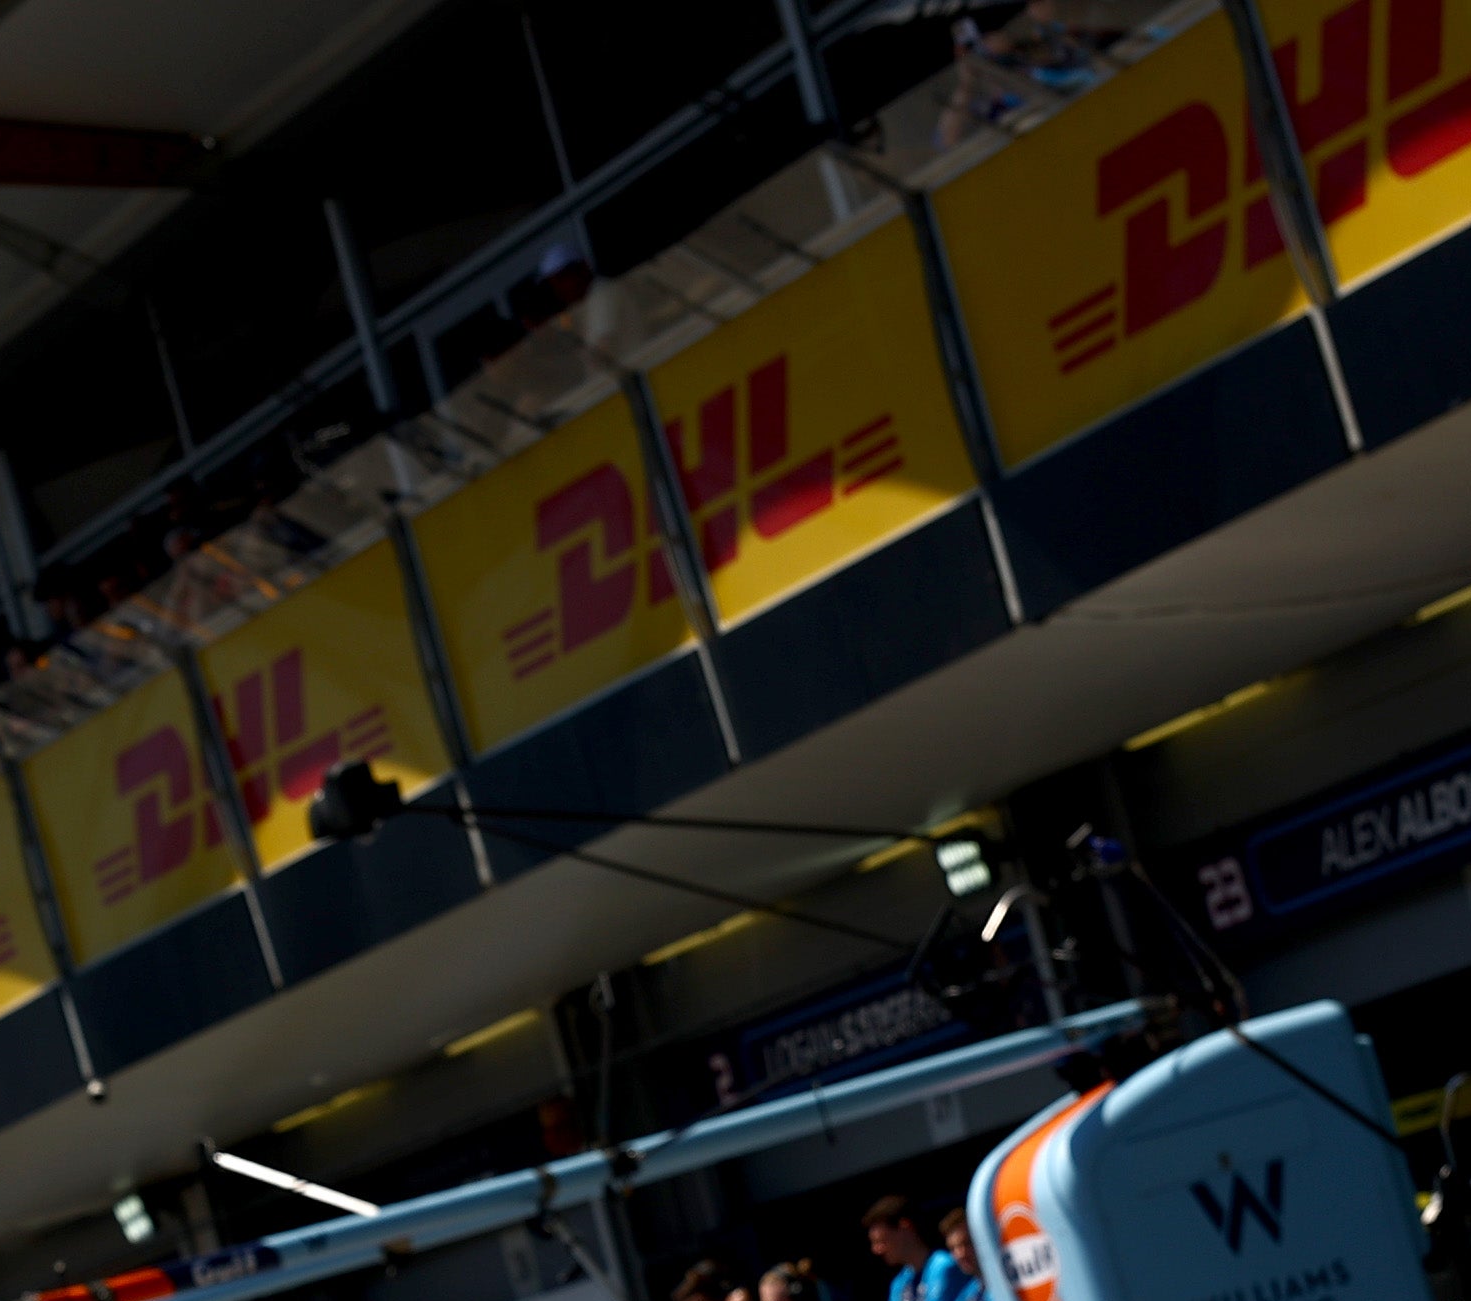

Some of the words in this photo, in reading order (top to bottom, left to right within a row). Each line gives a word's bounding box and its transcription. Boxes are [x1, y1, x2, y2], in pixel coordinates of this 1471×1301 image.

[536, 356, 834, 655] DHL
[116, 650, 342, 885] DHL
[1197, 855, 1254, 932] 23
